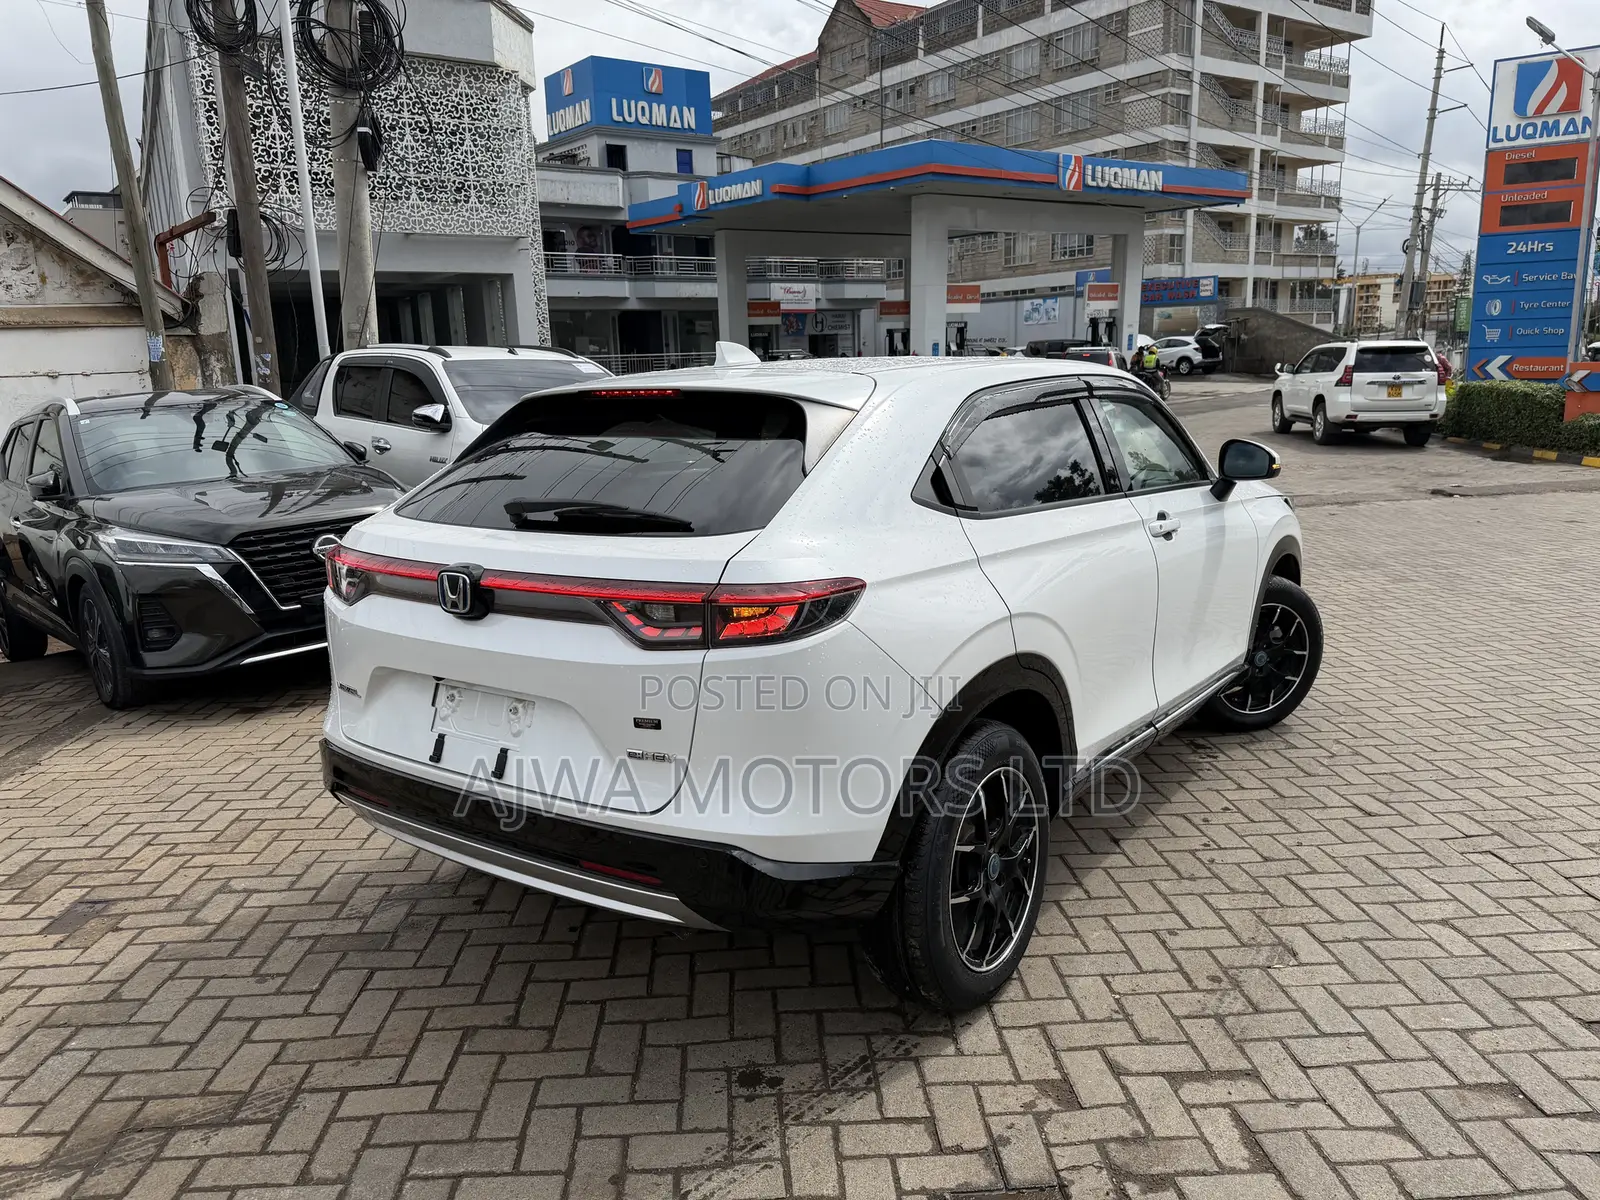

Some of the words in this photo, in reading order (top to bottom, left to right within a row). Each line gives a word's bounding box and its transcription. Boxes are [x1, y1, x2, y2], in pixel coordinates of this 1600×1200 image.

[548, 99, 591, 136] LUQMAN
[611, 97, 696, 130] LUQMAN
[1491, 116, 1593, 144] LUQMAN
[1505, 150, 1536, 161] Diesel
[1084, 164, 1163, 192] LUQMAN
[708, 179, 763, 204] LUQMAN
[1501, 191, 1548, 203] Unleaded
[1506, 240, 1554, 254] 24Hrs
[1522, 272, 1558, 282] Service
[1141, 279, 1199, 291] EXECUTIVE
[1142, 293, 1163, 302] CAR
[1167, 290, 1198, 300] WASH
[1519, 302, 1539, 311] Tyre
[1541, 300, 1571, 308] Center
[1516, 327, 1540, 335] Quick
[1543, 327, 1565, 337] Shop
[1512, 363, 1564, 372] Restaurant
